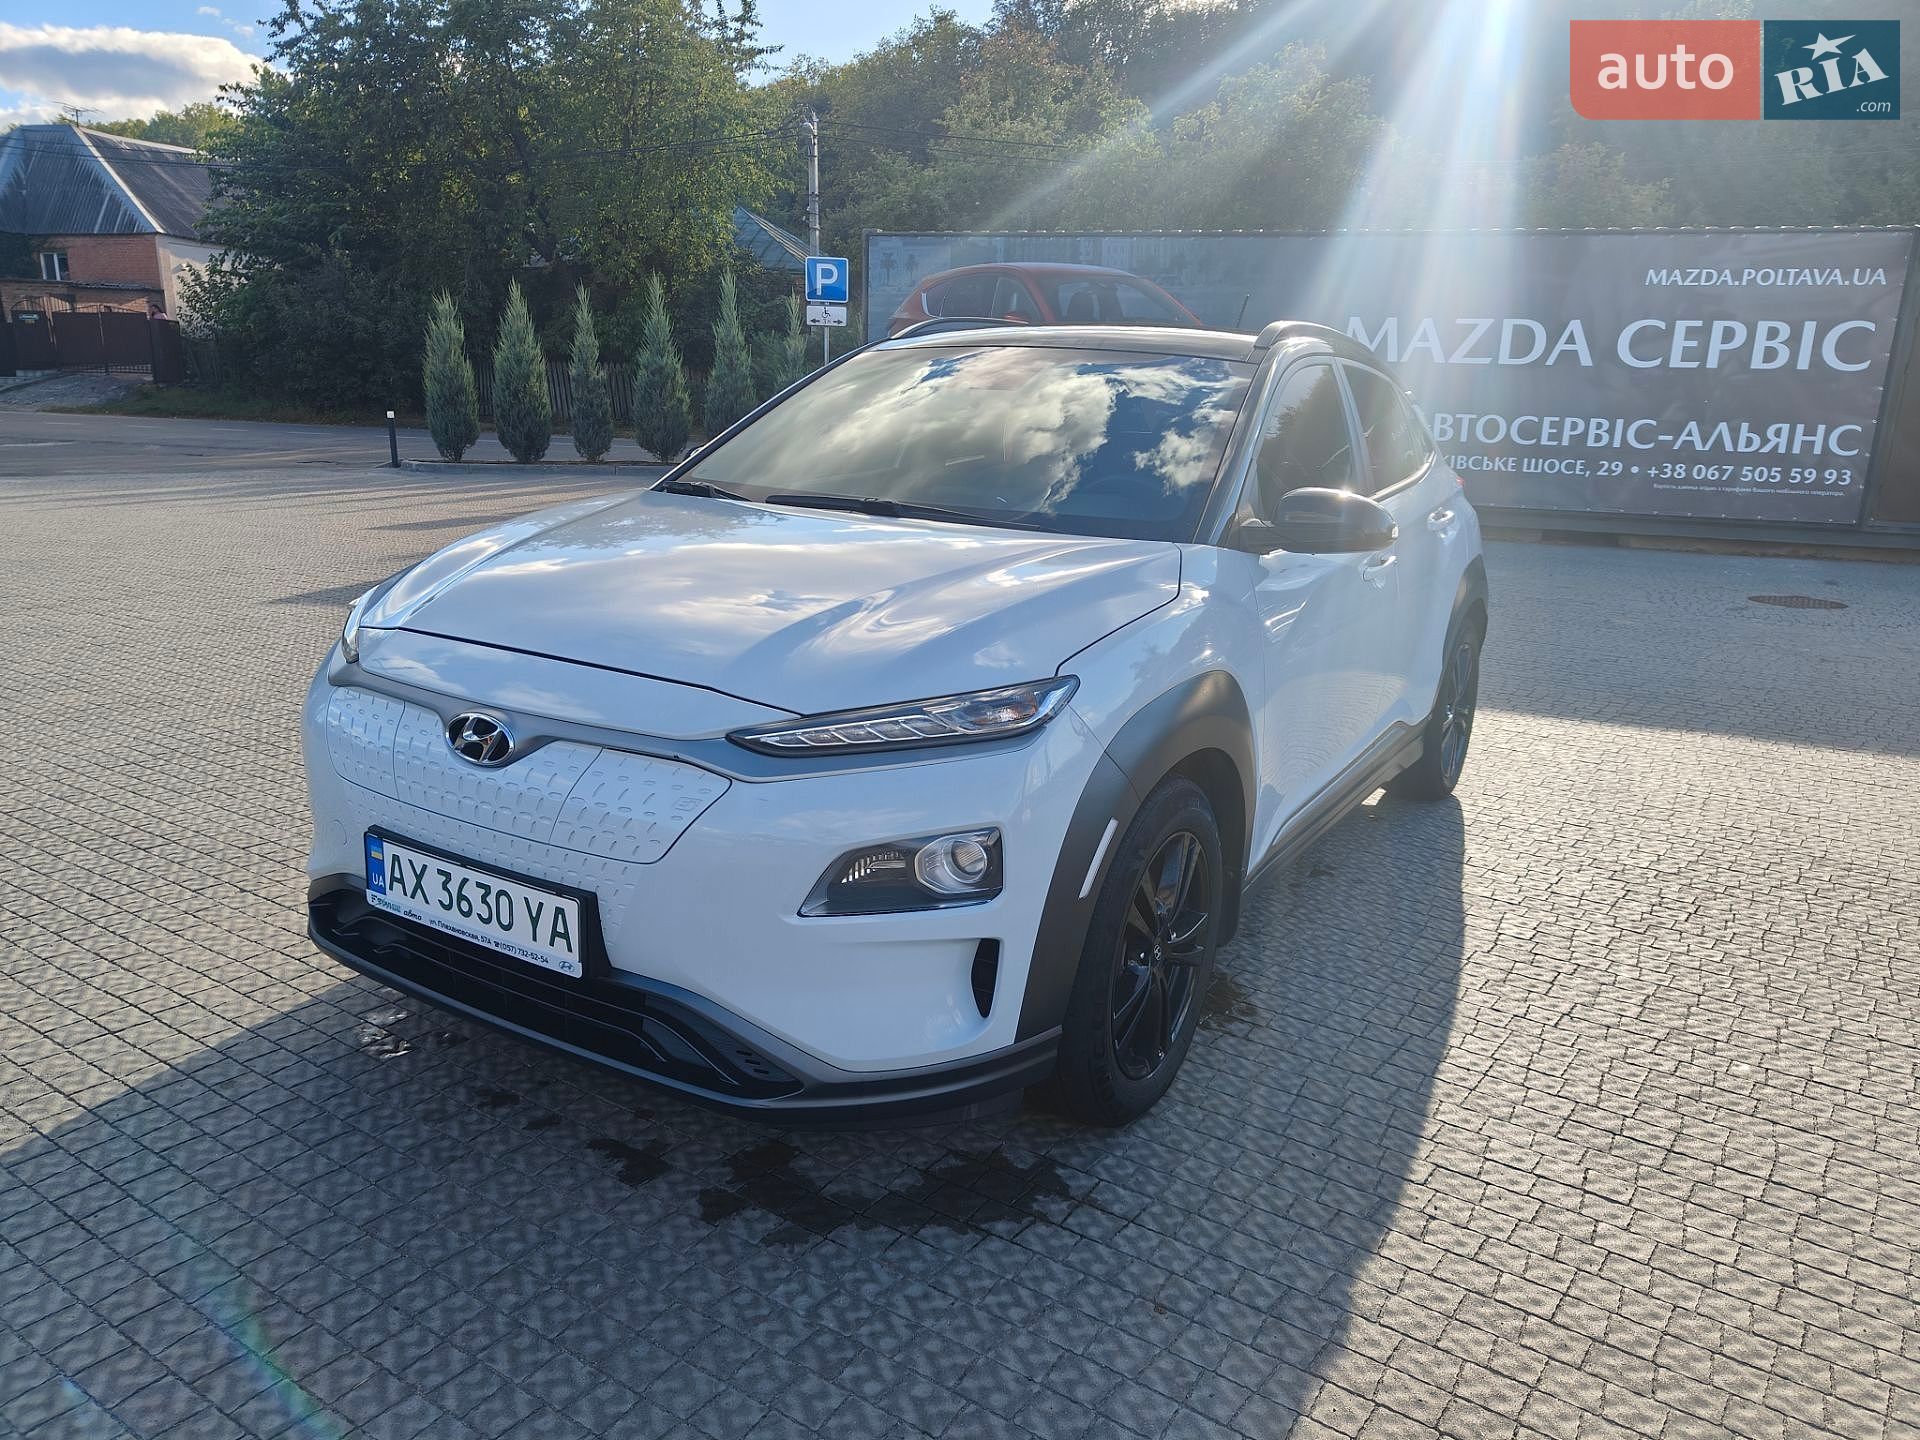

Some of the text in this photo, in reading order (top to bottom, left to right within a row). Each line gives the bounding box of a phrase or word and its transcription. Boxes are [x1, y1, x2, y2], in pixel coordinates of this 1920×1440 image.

[816, 263, 838, 296] P
[1645, 268, 1888, 286] MAZDA.POLTAVA.UA
[1346, 316, 1877, 371] MAZDA СЕРВІС
[1430, 412, 1863, 457] ВТОСЕРВІС-АЛЬЯНС
[1523, 457, 1591, 477] ШОСЕ,
[1597, 460, 1623, 476] 29
[1647, 463, 1686, 479] +38
[1693, 464, 1733, 481] 067
[1741, 466, 1782, 483] 505
[1789, 467, 1817, 484] 59
[1824, 469, 1852, 486] 93
[372, 873, 385, 887] UA
[389, 853, 573, 953] AX 3630 YA
